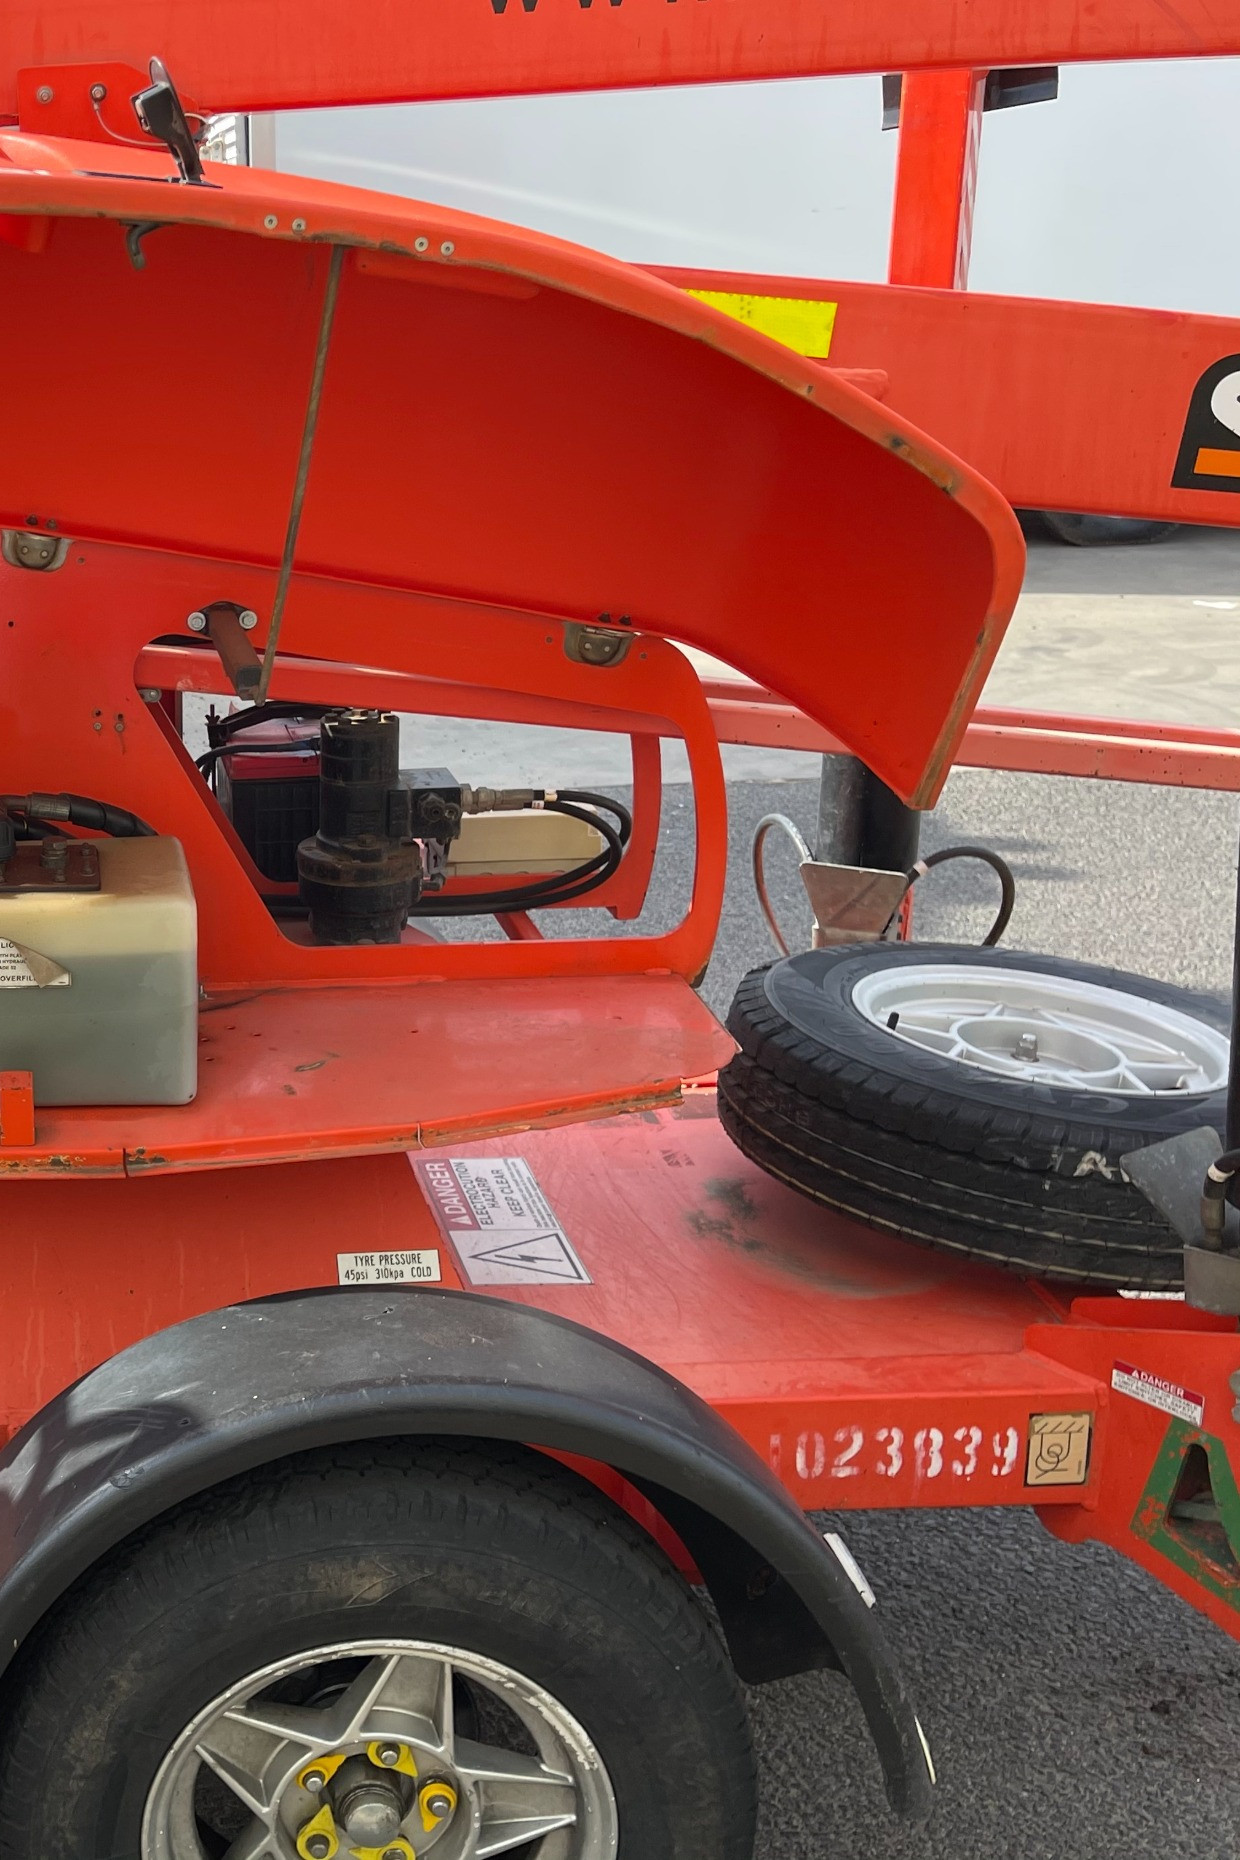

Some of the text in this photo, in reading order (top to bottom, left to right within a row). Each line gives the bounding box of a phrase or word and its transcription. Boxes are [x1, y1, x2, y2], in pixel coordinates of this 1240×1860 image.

[425, 1162, 467, 1214] DANGER
[453, 1162, 494, 1226] ELECTROCUTION
[475, 1176, 500, 1209] HAZARD
[491, 1168, 526, 1217] KEEP CLEAR
[344, 1266, 432, 1282] 45psi 310kpa COLD
[354, 1253, 422, 1267] TYRE PRESSURE
[1140, 1371, 1185, 1399] DANGER
